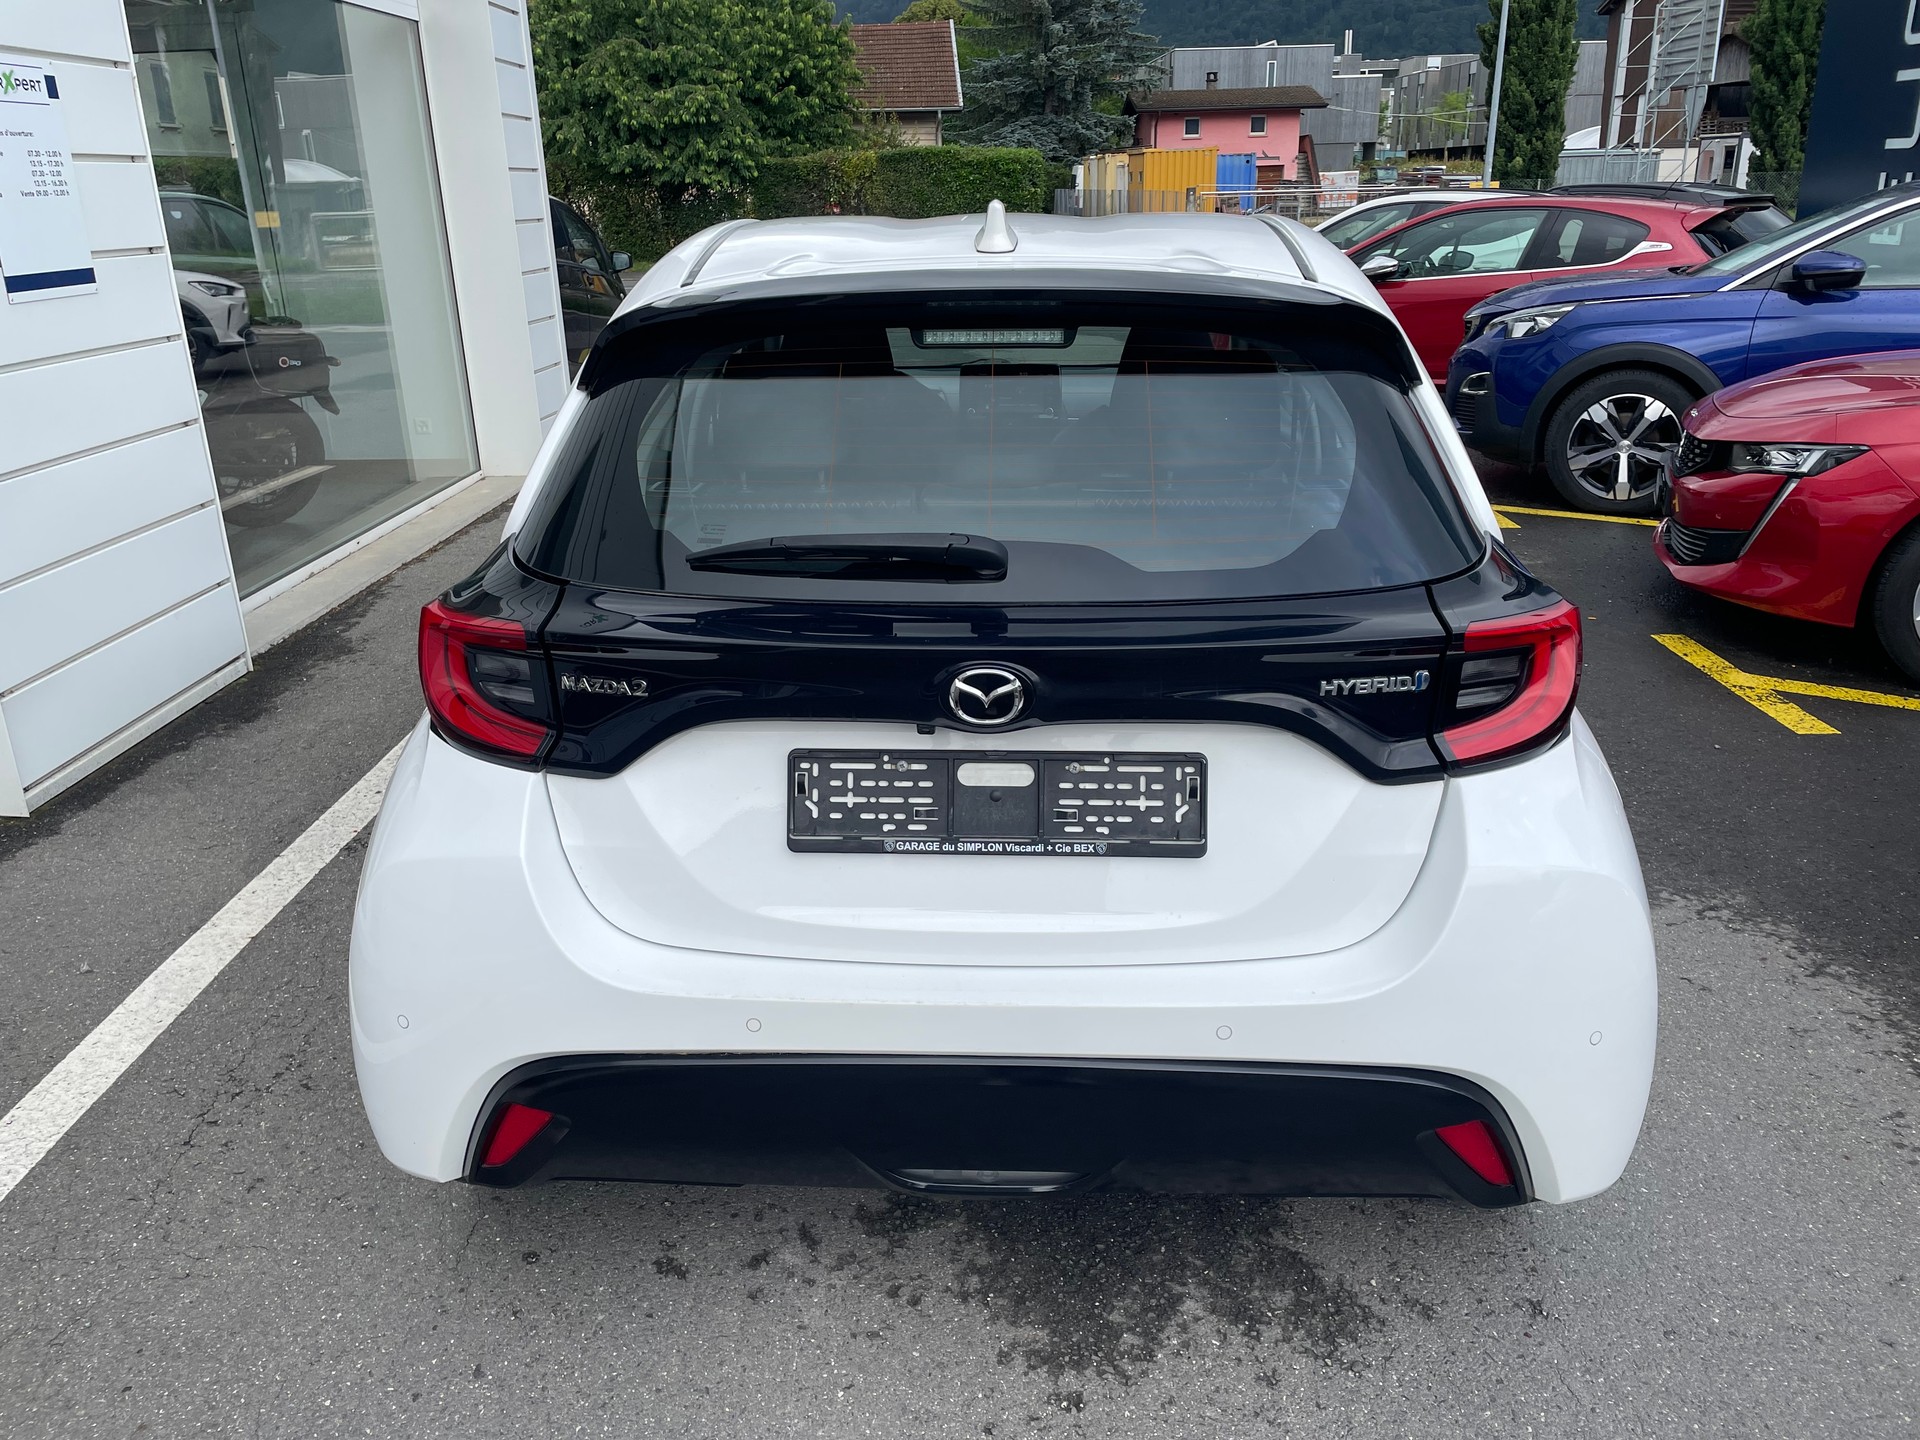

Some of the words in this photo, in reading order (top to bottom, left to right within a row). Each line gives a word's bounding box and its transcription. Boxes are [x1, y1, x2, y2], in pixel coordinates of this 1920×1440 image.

[1319, 676, 1412, 697] HYBRID
[896, 841, 940, 851] GARAGE
[942, 841, 955, 852] du
[957, 842, 1003, 853] SIMPLON
[1005, 842, 1045, 853] Viscardi
[1055, 843, 1071, 853] Cie
[1074, 843, 1095, 853] BEX
